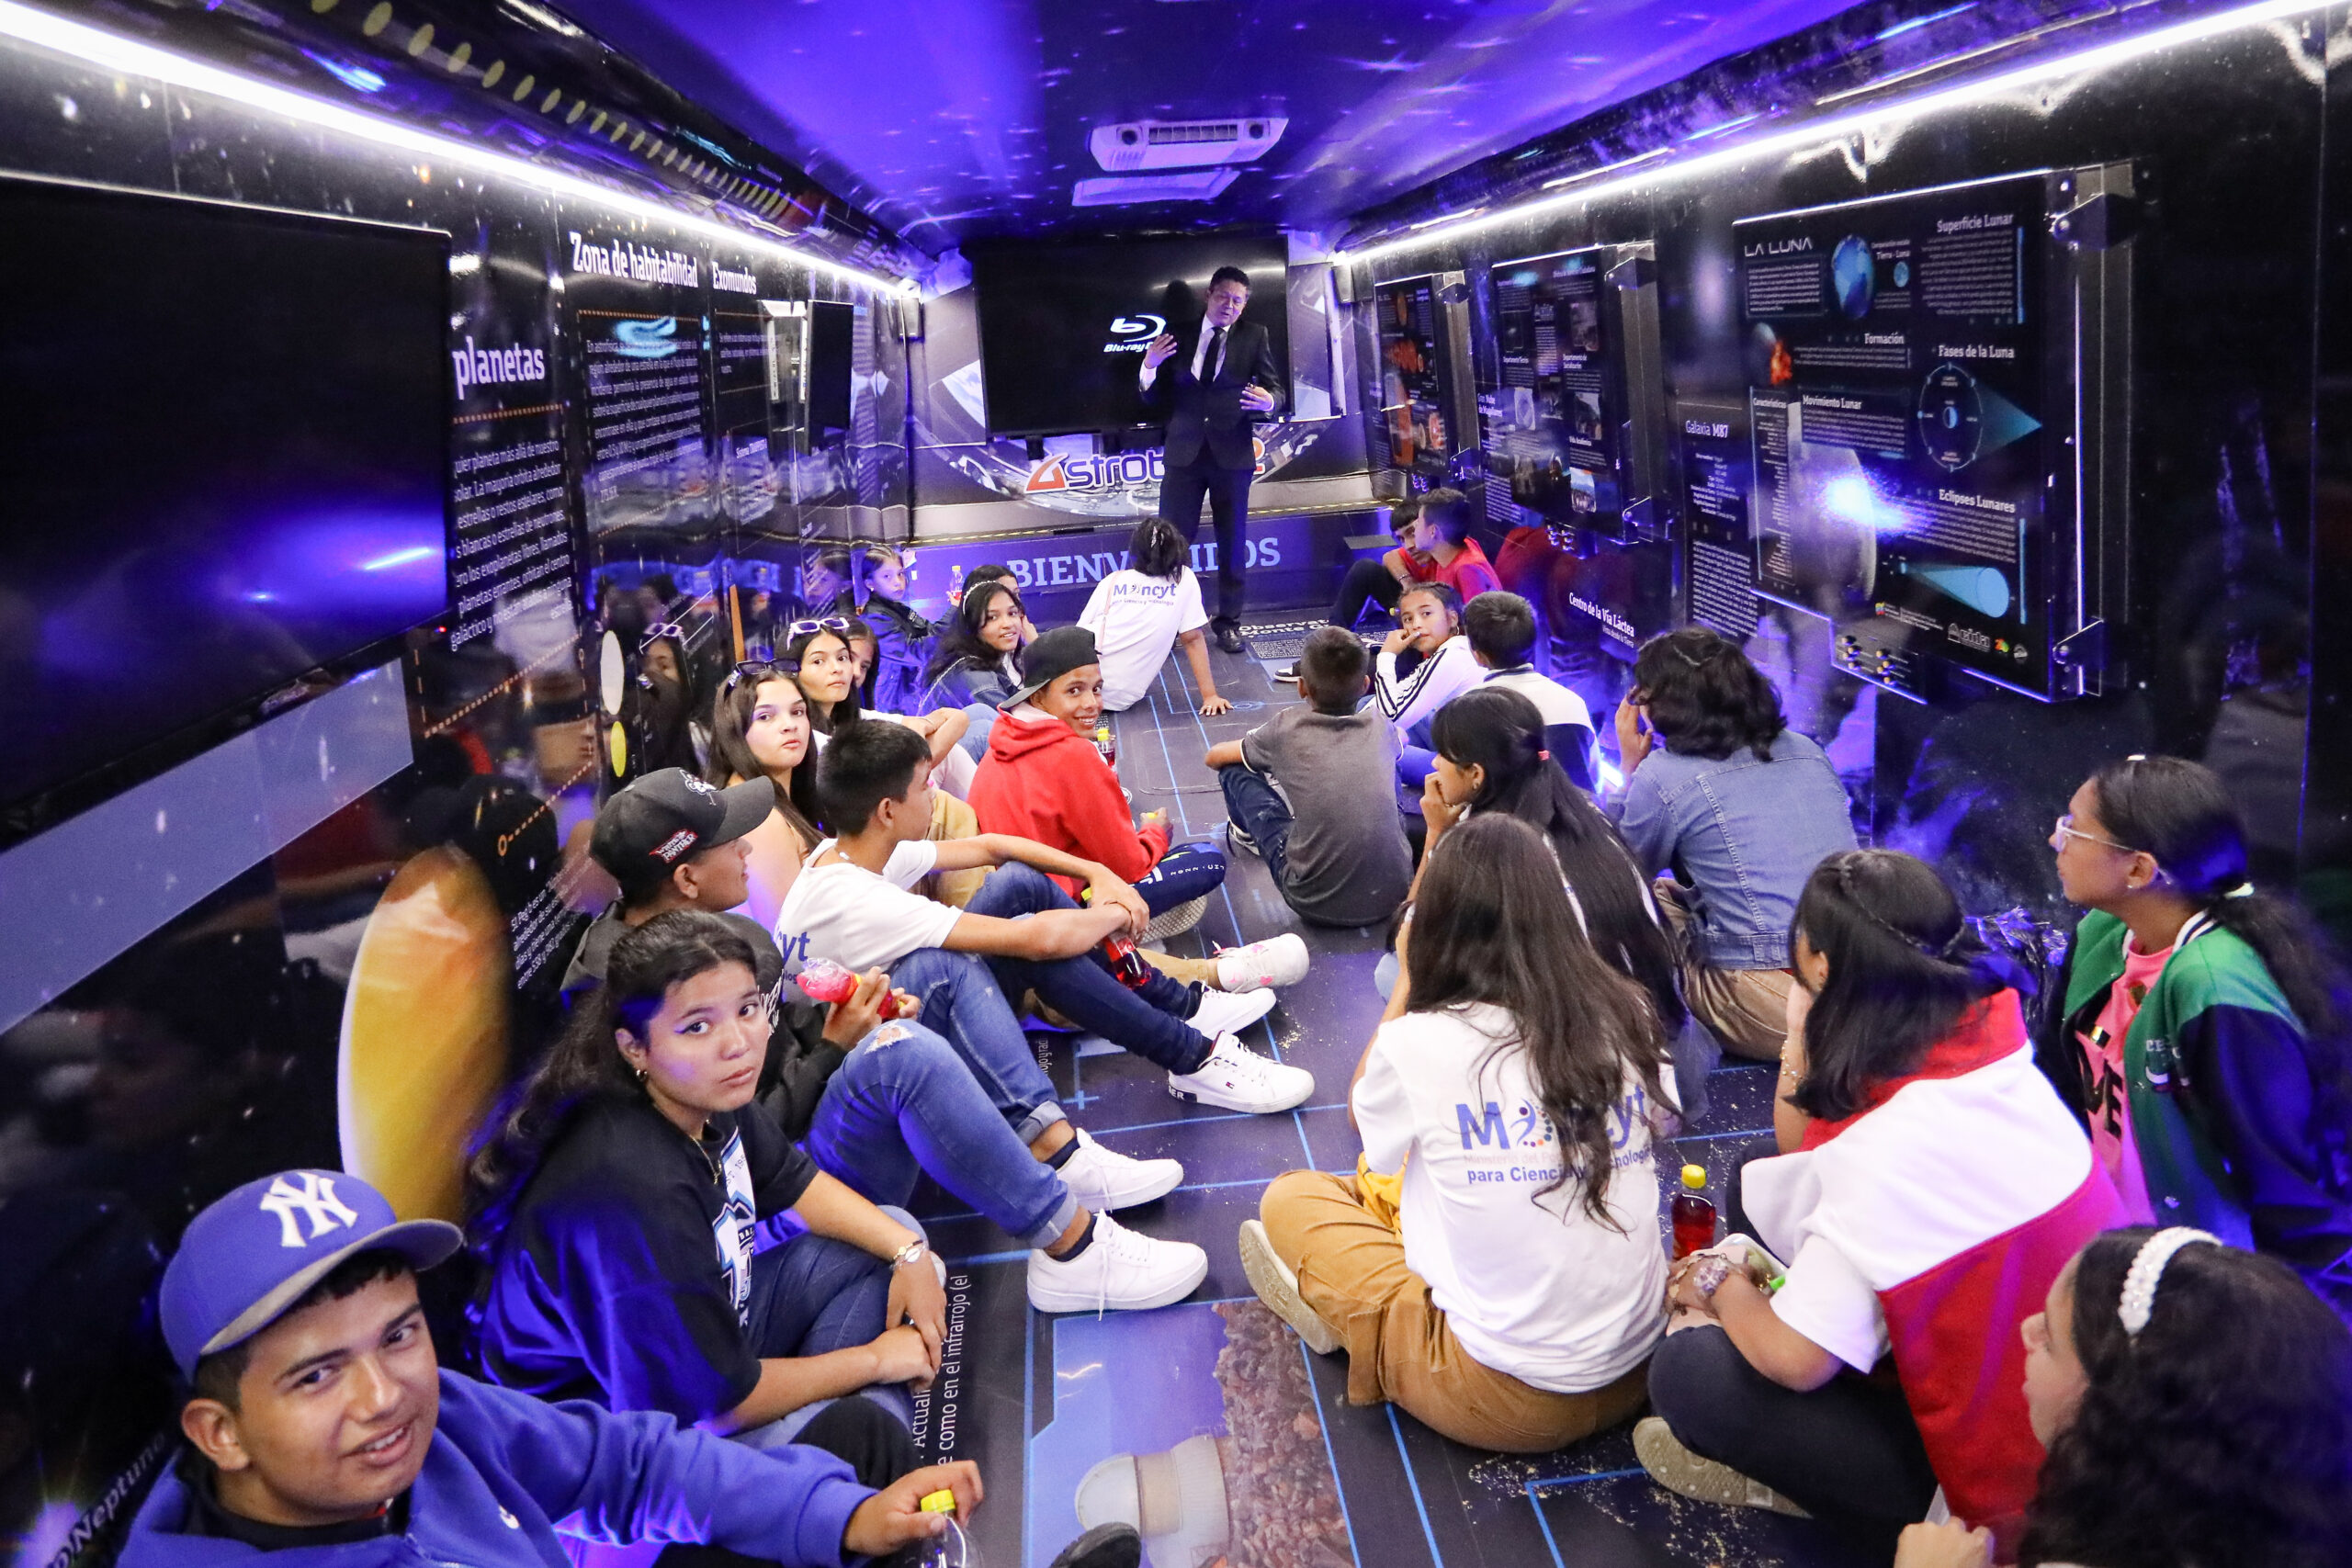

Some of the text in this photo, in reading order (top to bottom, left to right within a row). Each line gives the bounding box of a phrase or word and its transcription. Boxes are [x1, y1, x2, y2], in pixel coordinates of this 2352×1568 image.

[1937, 214, 2014, 234] Superficie Lunar
[569, 231, 698, 288] Zona de habitabilidad
[1745, 237, 1813, 256] LA LUNA
[712, 262, 757, 295] Exomundos
[1103, 344, 1145, 353] Blu-ray
[1864, 332, 1905, 344] Formación
[1939, 344, 2015, 358] Fases de la Luna
[452, 335, 546, 400] planetas
[1803, 395, 1862, 410] Movimiento Lunar
[1685, 420, 1728, 438] Galaxia M87
[472, 451, 499, 474] planeta
[500, 445, 514, 462] más
[526, 441, 534, 457] de
[535, 440, 559, 456] nuestro
[475, 480, 485, 497] La
[485, 471, 514, 496] mayoría
[514, 468, 532, 486] orbita
[533, 460, 560, 480] alrededor
[496, 500, 516, 516] restos
[546, 486, 563, 501] como
[1939, 489, 2016, 513] Eclipses Lunares
[462, 534, 492, 557] blancas
[526, 516, 533, 533] de
[1007, 536, 1282, 591] BIENVIS
[458, 589, 492, 620] planetas
[551, 554, 570, 571] centro
[1113, 582, 1177, 599] Mncyt
[1569, 592, 1634, 637] Centro de la Vía Láctea
[1467, 1169, 1504, 1185] para
[259, 1171, 358, 1247] NY
[939, 1275, 971, 1450] como en el infrarrojo (el
